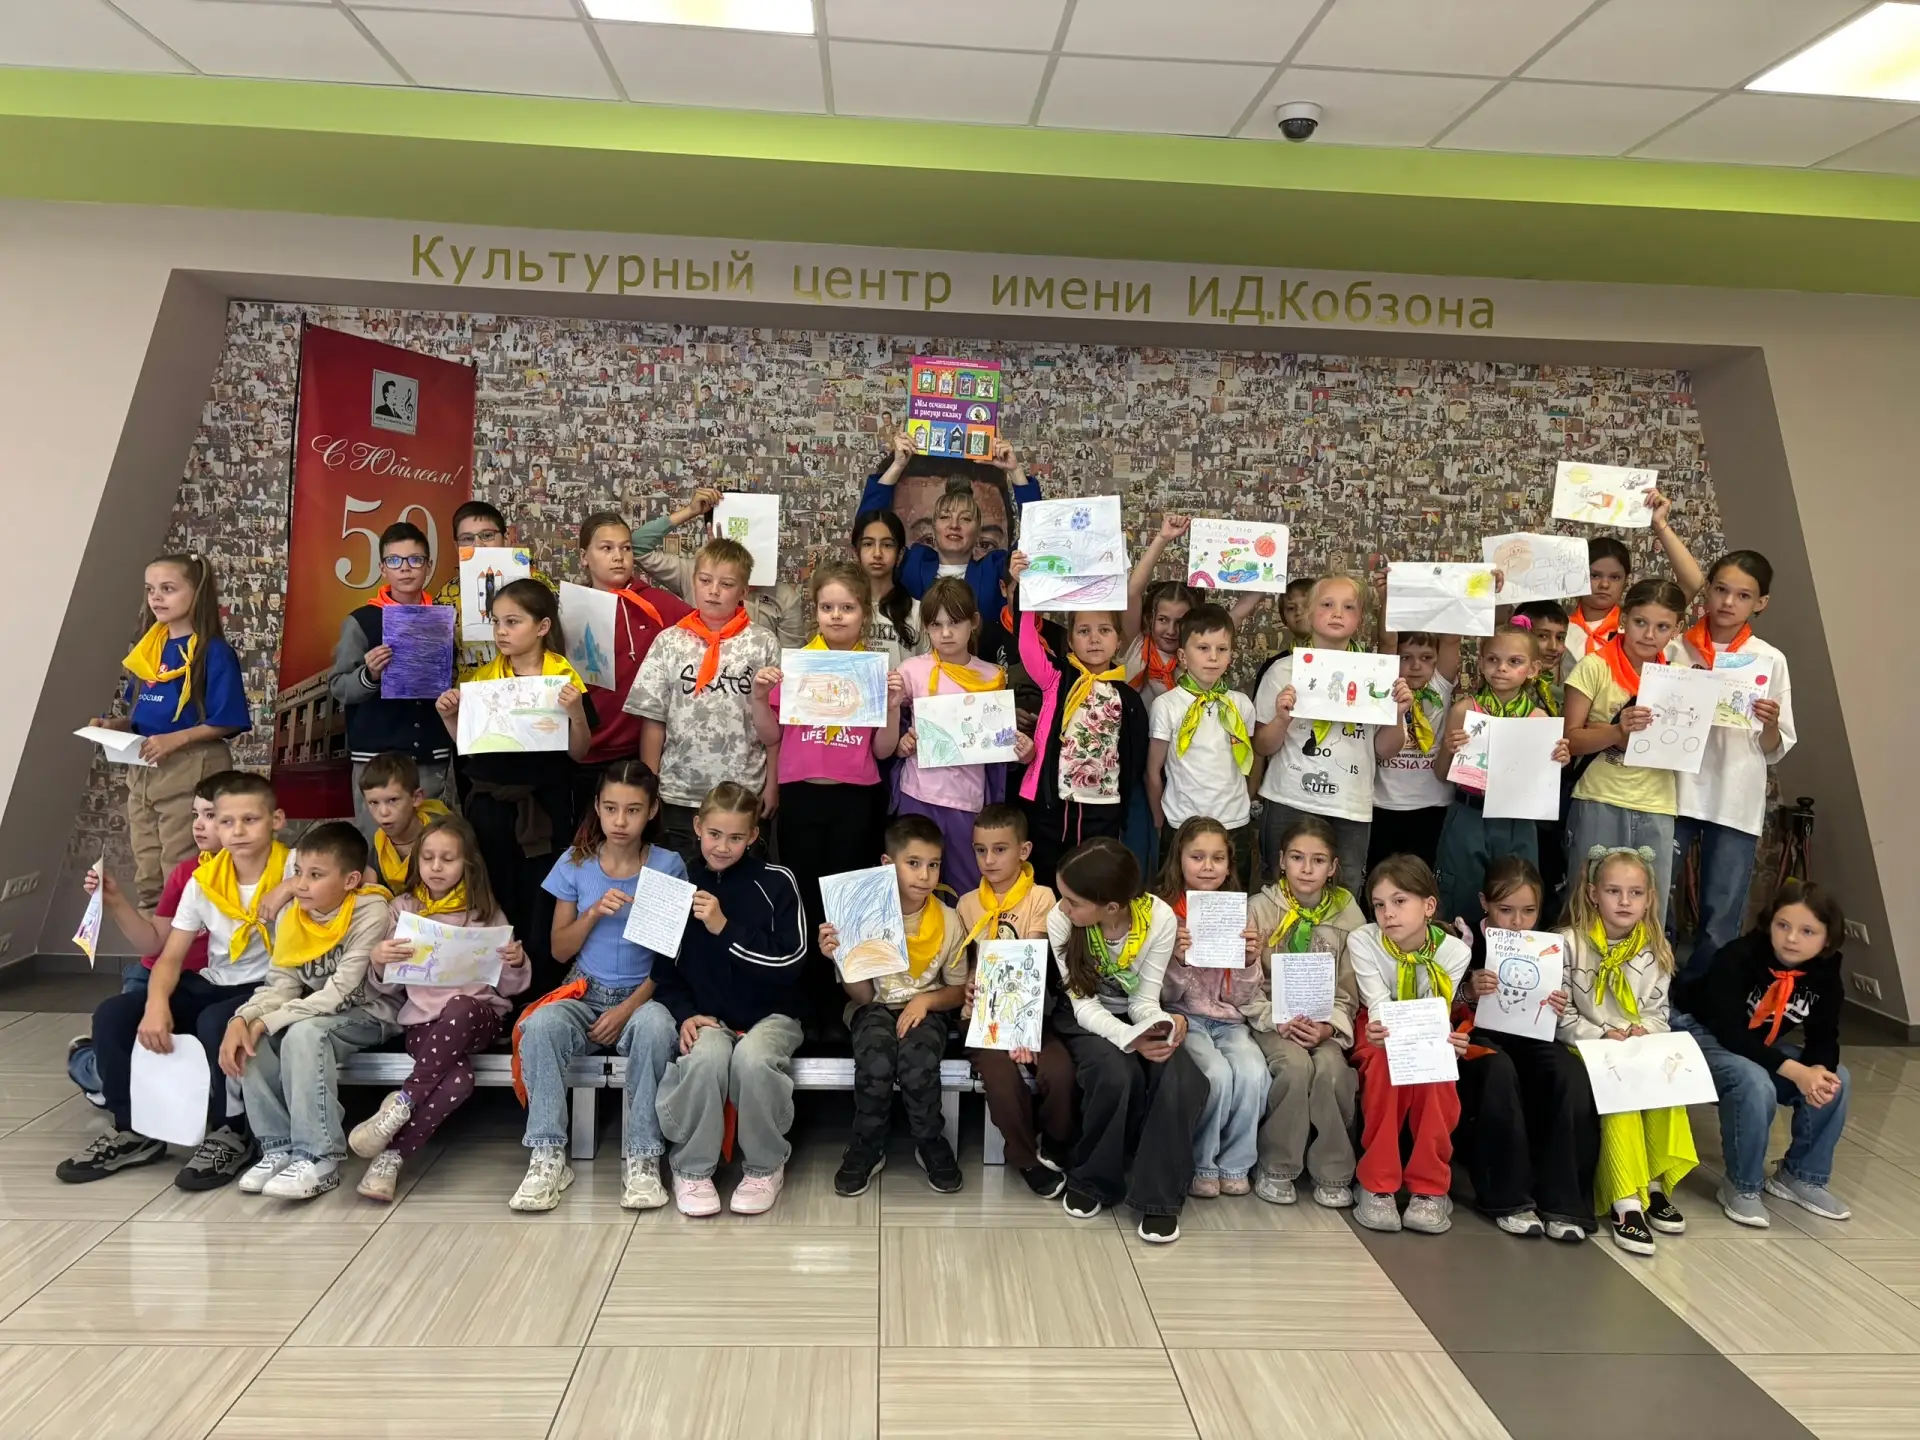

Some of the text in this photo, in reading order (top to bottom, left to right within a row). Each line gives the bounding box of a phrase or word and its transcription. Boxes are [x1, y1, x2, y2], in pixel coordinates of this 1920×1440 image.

[412, 234, 1496, 330] Культурный центр имени И.Д.Кобзона
[311, 435, 464, 486] С Юбилеем!
[335, 494, 438, 590] 50
[801, 730, 823, 742] LIFE
[836, 732, 863, 746] EASY
[1350, 764, 1359, 775] IS
[1304, 782, 1337, 794] CUTE
[1619, 1223, 1650, 1240] LOVE
